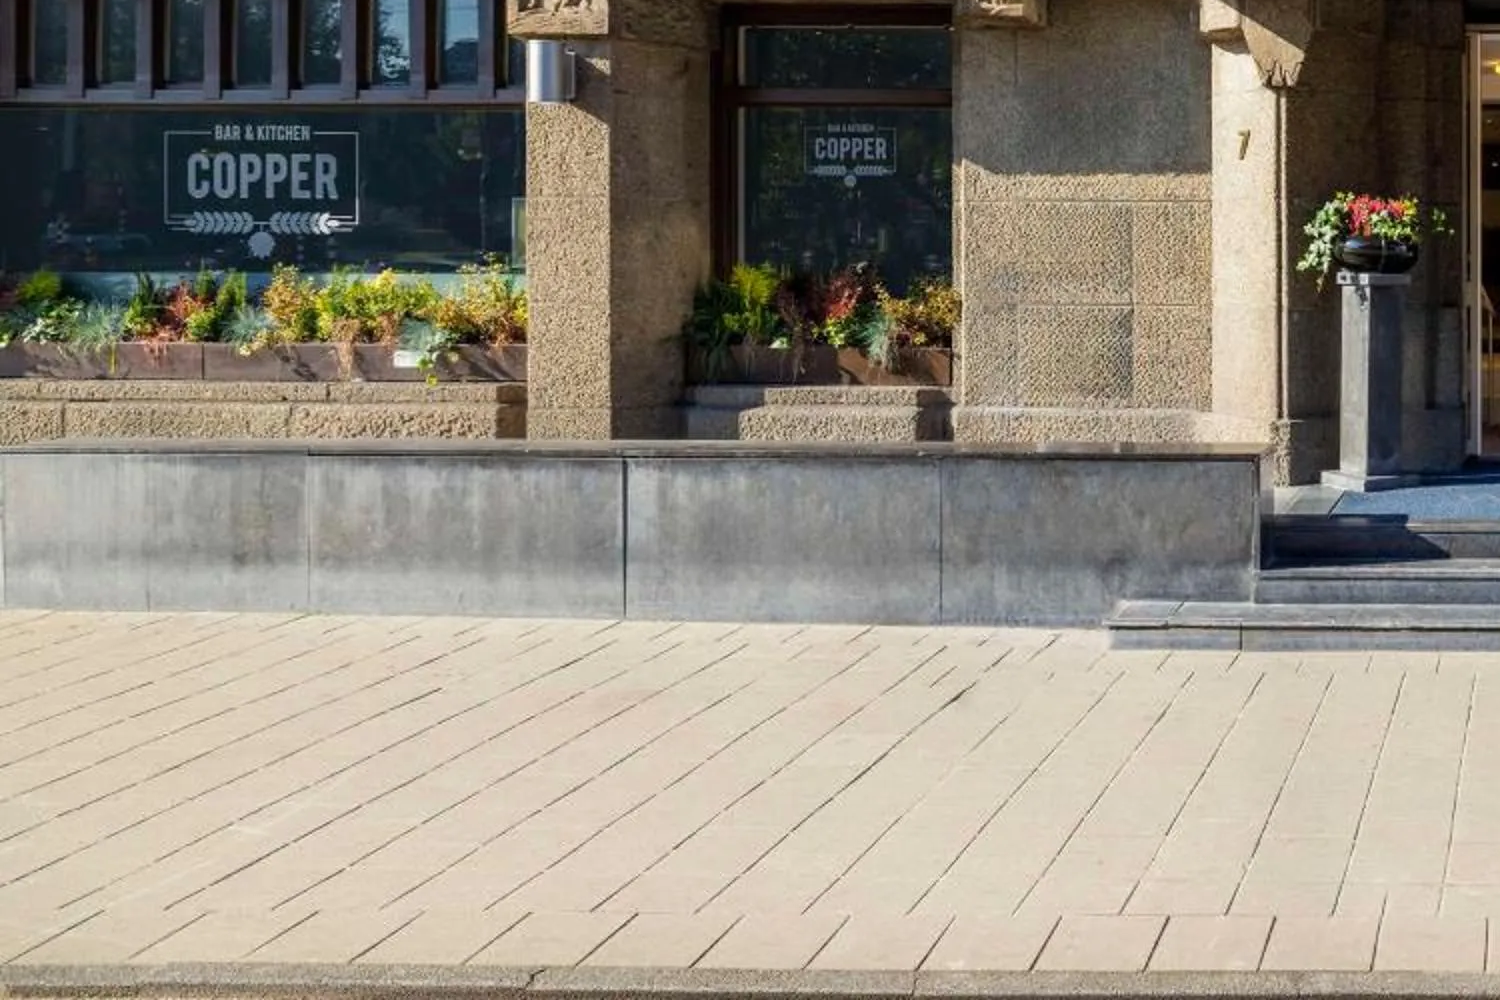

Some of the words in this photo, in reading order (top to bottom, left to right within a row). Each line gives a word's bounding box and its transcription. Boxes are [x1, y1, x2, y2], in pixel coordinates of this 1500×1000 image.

[215, 124, 241, 141] BAR
[244, 124, 255, 141] &
[256, 124, 311, 141] KITCHEN
[1237, 129, 1251, 160] 7
[815, 137, 888, 160] COPPER
[187, 152, 339, 200] COPPER
